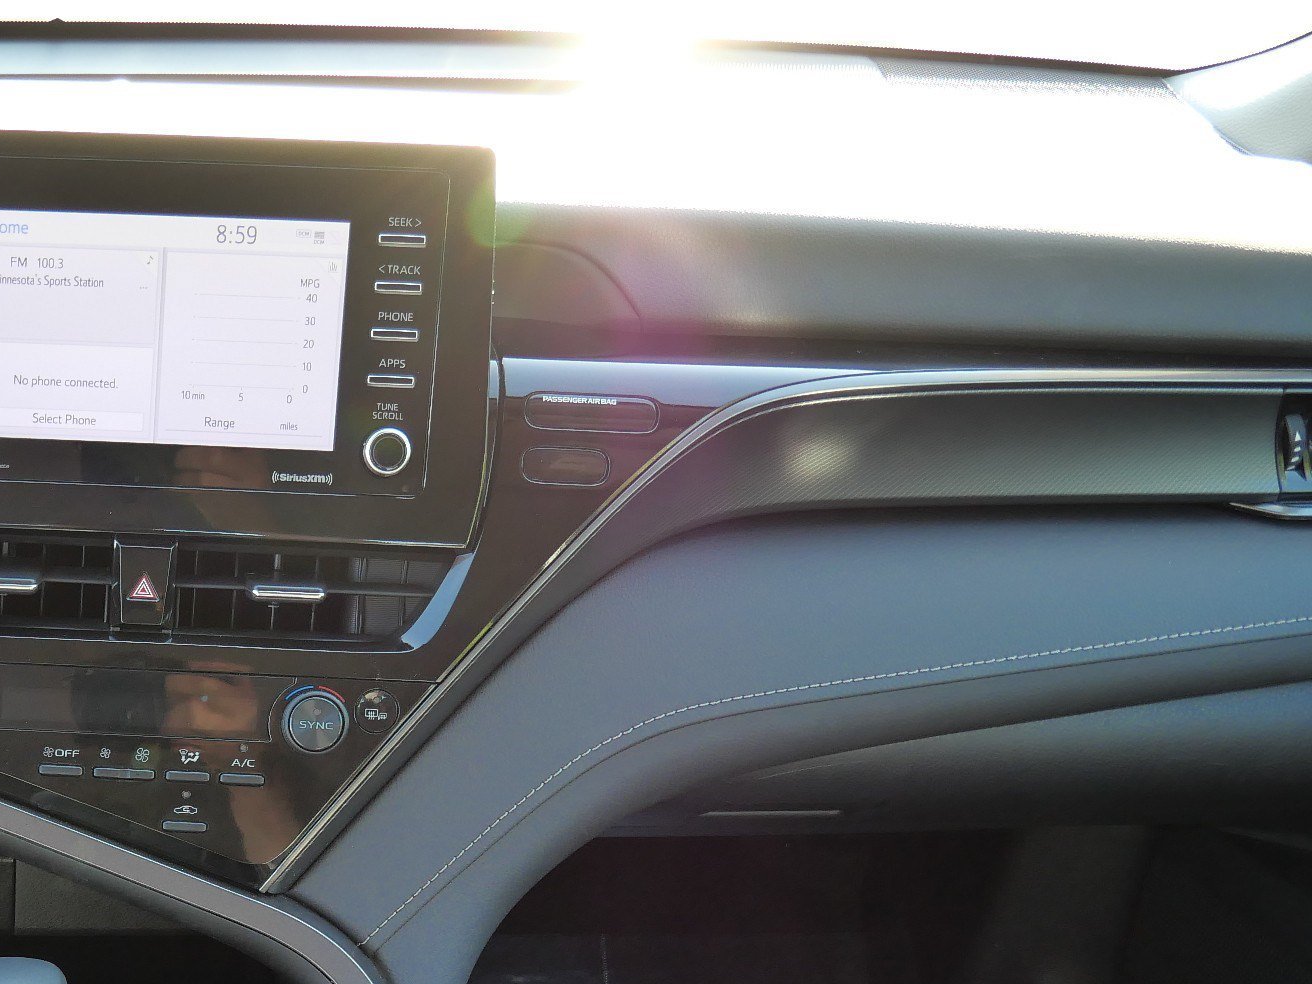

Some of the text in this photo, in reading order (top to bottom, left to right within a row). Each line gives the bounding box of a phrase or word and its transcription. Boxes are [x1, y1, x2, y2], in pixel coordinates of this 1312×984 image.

[389, 217, 413, 228] SEEK
[216, 225, 258, 245] 8:59
[10, 256, 64, 269] FM 100.3
[388, 265, 421, 276] TRACK
[44, 274, 72, 288] Sports
[74, 276, 104, 288] Station
[300, 278, 320, 289] MPG
[306, 293, 318, 304] 40
[304, 316, 316, 326] 30
[377, 311, 414, 322] PHONE
[302, 339, 315, 349] 20
[302, 362, 312, 372] 10
[378, 358, 406, 369] APPS
[13, 374, 119, 389] No phone connected.
[302, 384, 309, 394] 0
[181, 390, 293, 404] 10 min 5 0
[542, 395, 588, 404] PASSENGER
[376, 402, 399, 412] TUNE
[32, 412, 97, 426] Select Phone
[372, 411, 404, 421] SCROLL
[204, 416, 298, 431] Range miles
[299, 720, 335, 730] SYNC
[54, 749, 80, 758] OFF
[231, 758, 256, 768] A/C
